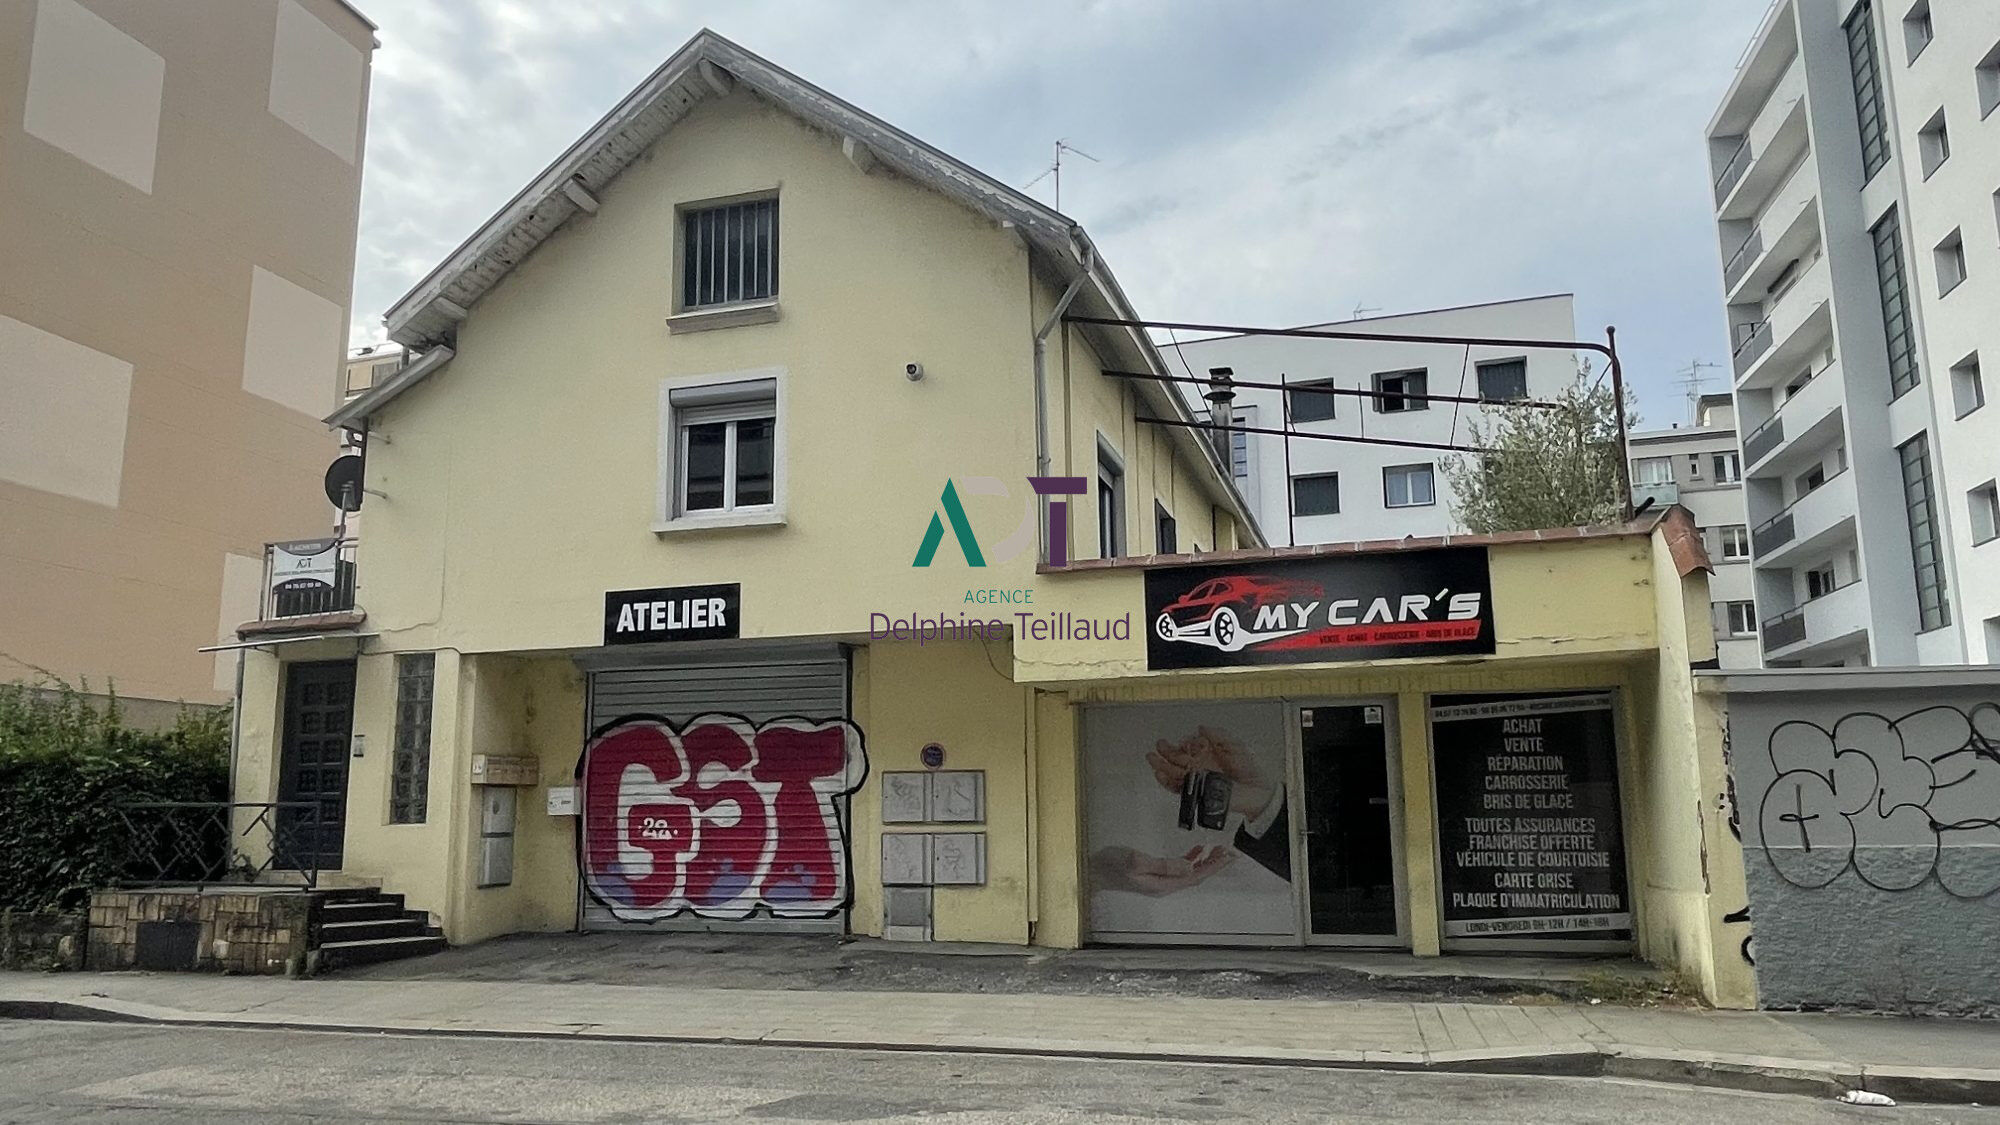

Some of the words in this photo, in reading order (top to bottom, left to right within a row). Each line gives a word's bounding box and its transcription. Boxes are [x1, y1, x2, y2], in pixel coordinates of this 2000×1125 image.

[616, 597, 726, 633] ATELIER
[1253, 602, 1319, 630] MY
[1502, 718, 1543, 734] ACHAT
[1503, 736, 1544, 753] VENTE
[1485, 774, 1569, 790] CARROSSERIE
[1483, 794, 1513, 810] BRIS
[1515, 794, 1532, 809] DE
[1534, 793, 1574, 809] GLACE
[1465, 817, 1512, 833] TOUTES
[1514, 817, 1596, 833] ASSURANCES
[1469, 835, 1539, 850] FRANCHISE
[1540, 835, 1595, 850] OFFERTE
[1456, 849, 1516, 868] VÉHICULE
[1518, 852, 1535, 867] DE
[1537, 852, 1610, 868] COURTOISIE
[1494, 873, 1534, 888] CARTE
[1537, 872, 1574, 889] GRISE
[1453, 893, 1497, 908] PLAQUE
[1500, 893, 1620, 909] D'IMMATRICULATION
